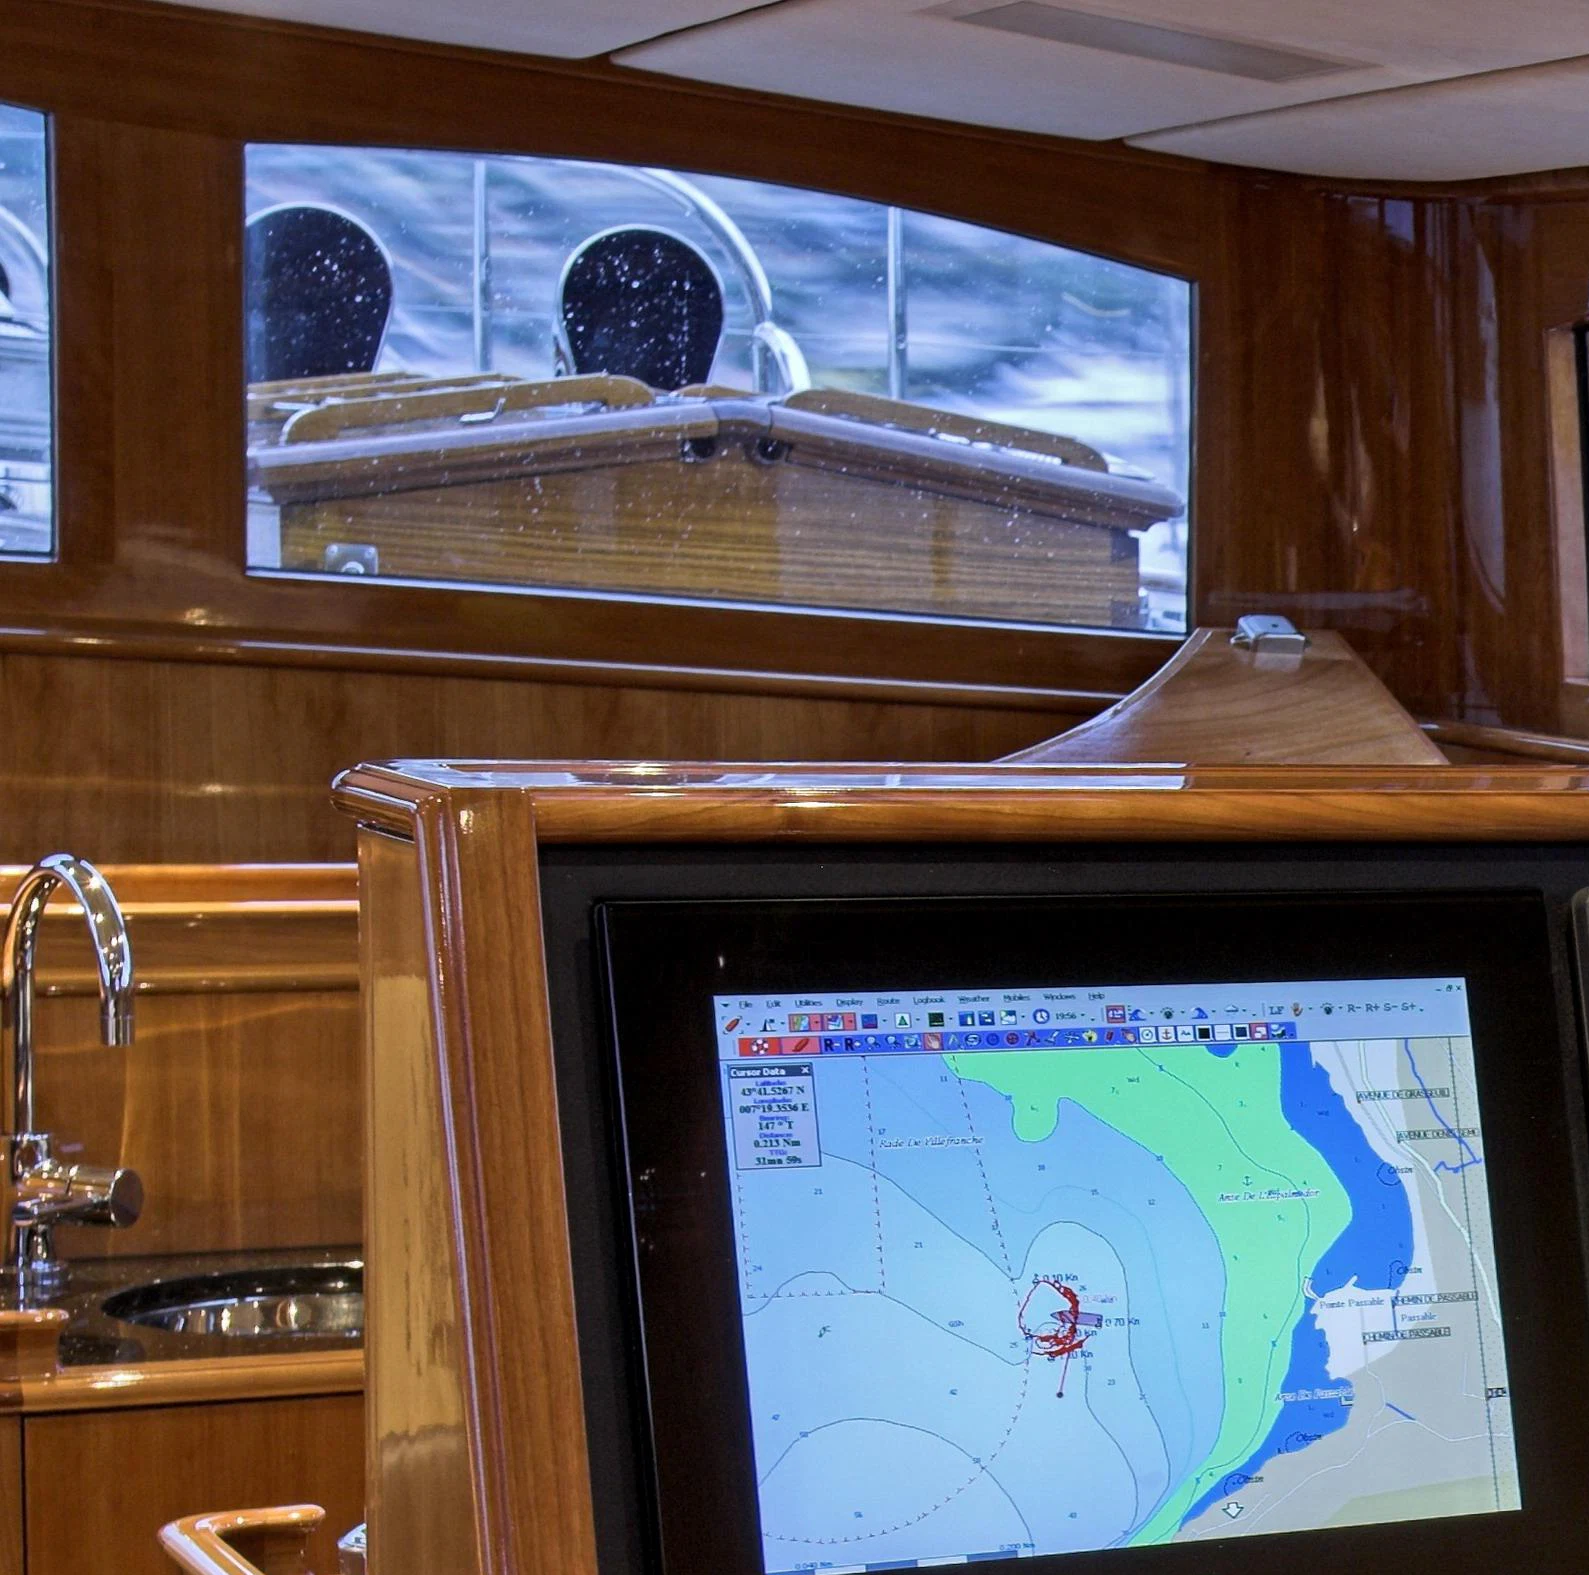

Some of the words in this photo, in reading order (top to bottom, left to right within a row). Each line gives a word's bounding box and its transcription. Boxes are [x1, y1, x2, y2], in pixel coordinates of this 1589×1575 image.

[836, 997, 863, 1008] Display
[913, 995, 945, 1006] Logbook
[1043, 992, 1076, 1001] Windows
[730, 1067, 760, 1077] Cursor
[762, 1066, 787, 1076] Data
[758, 1121, 775, 1131] 147
